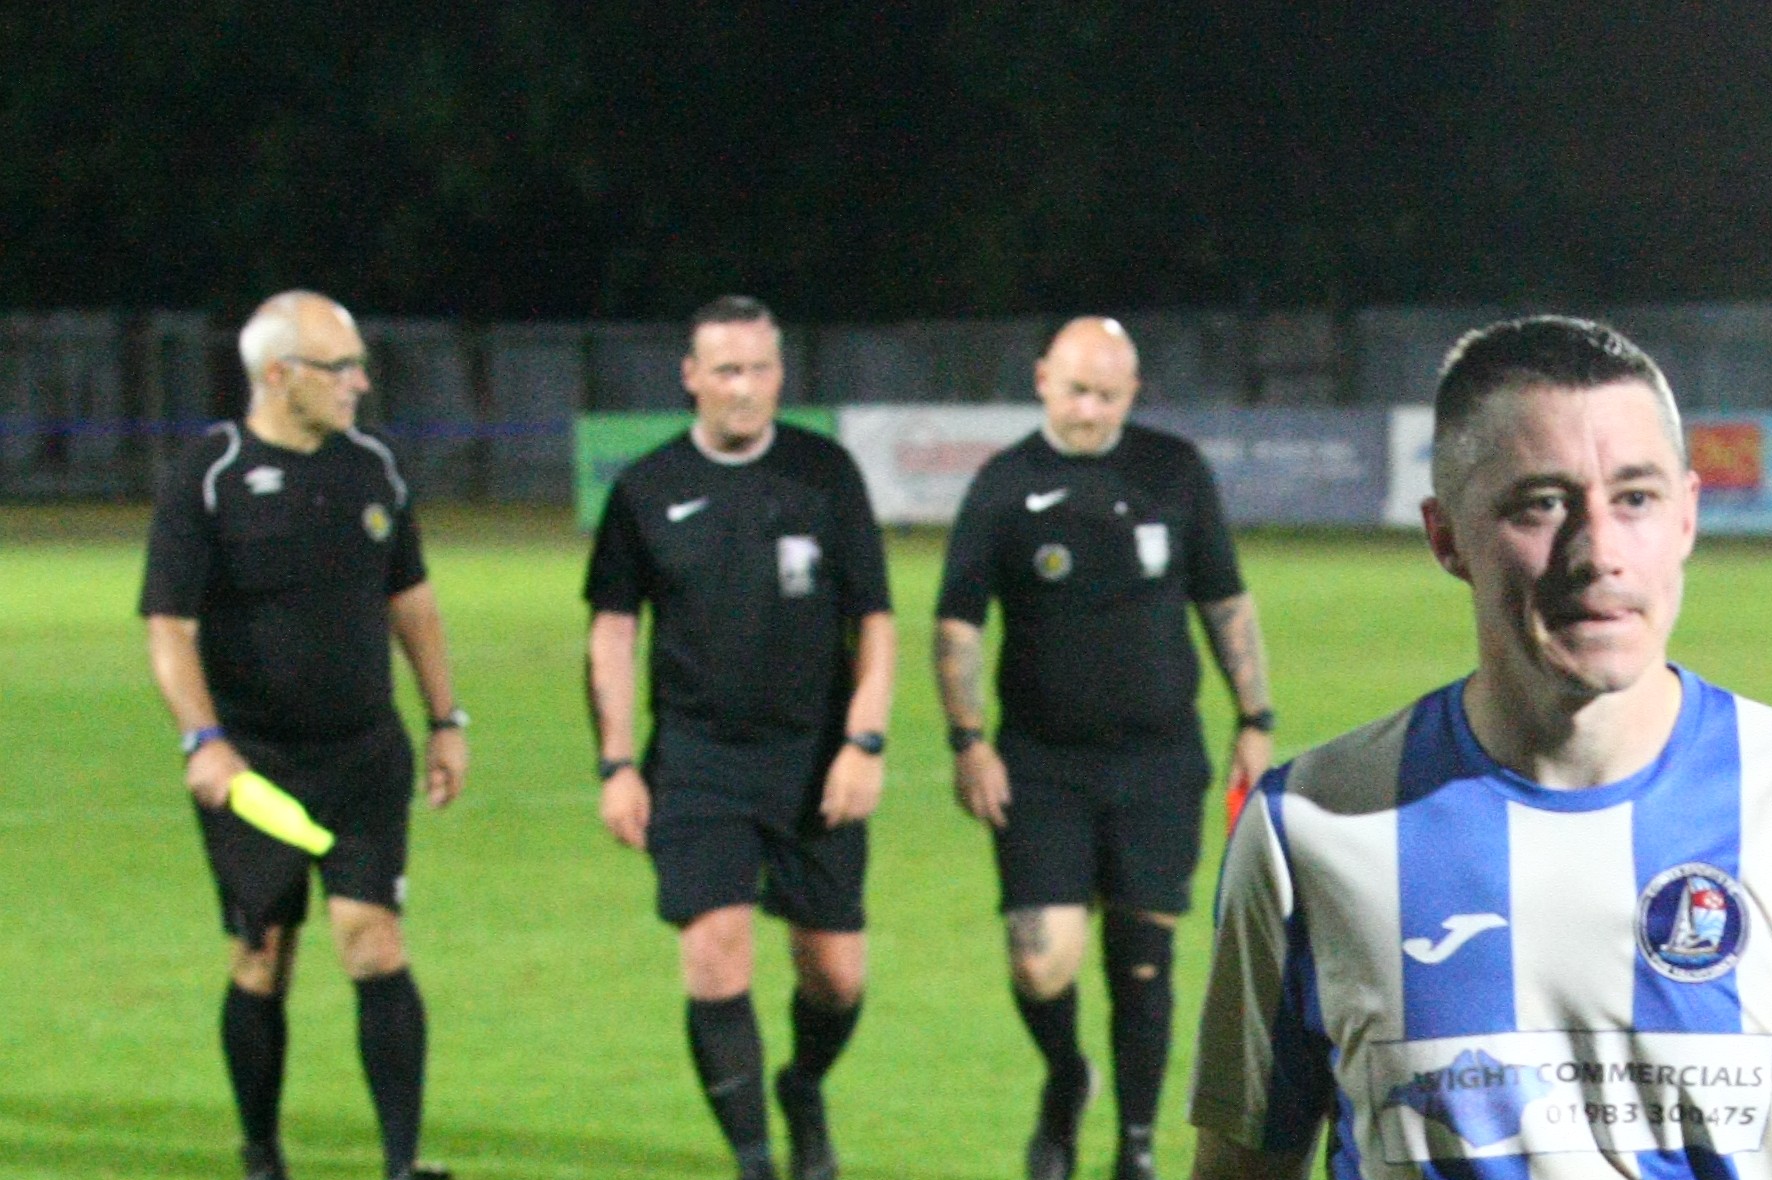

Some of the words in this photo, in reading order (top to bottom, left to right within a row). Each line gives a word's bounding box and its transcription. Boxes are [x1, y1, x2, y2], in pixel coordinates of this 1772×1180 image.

[1414, 1064, 1519, 1093] WIGHT
[1537, 1061, 1763, 1087] COMMERCIALS
[1546, 1102, 1638, 1125] 01983
